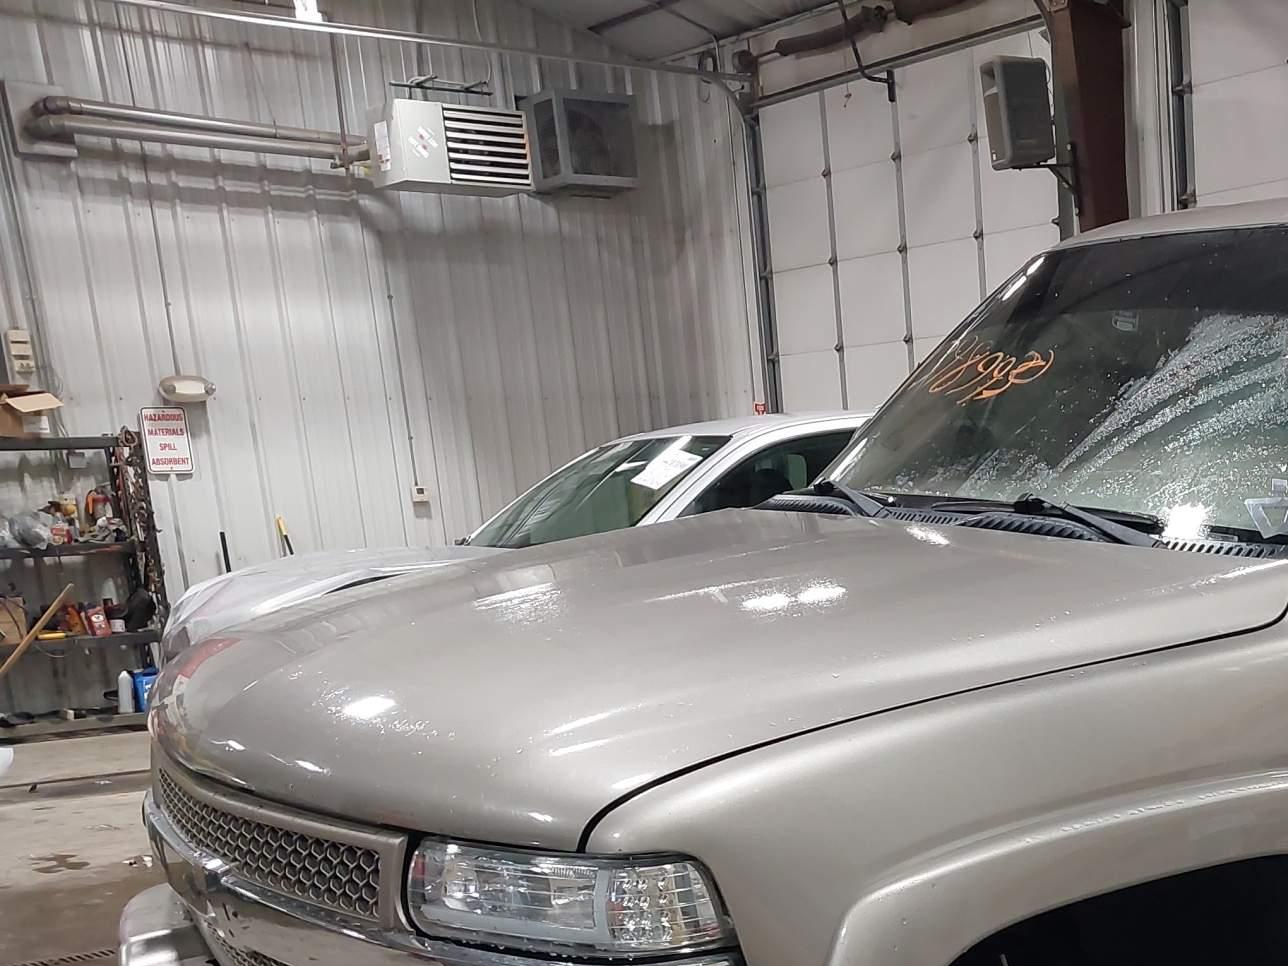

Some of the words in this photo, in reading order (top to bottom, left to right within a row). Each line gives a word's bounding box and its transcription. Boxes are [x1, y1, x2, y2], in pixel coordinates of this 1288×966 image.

[143, 413, 184, 422] HAZARDOUS
[147, 428, 185, 436] MATERIALS
[159, 442, 178, 451] SPILL
[151, 457, 190, 466] ABSORBENT
